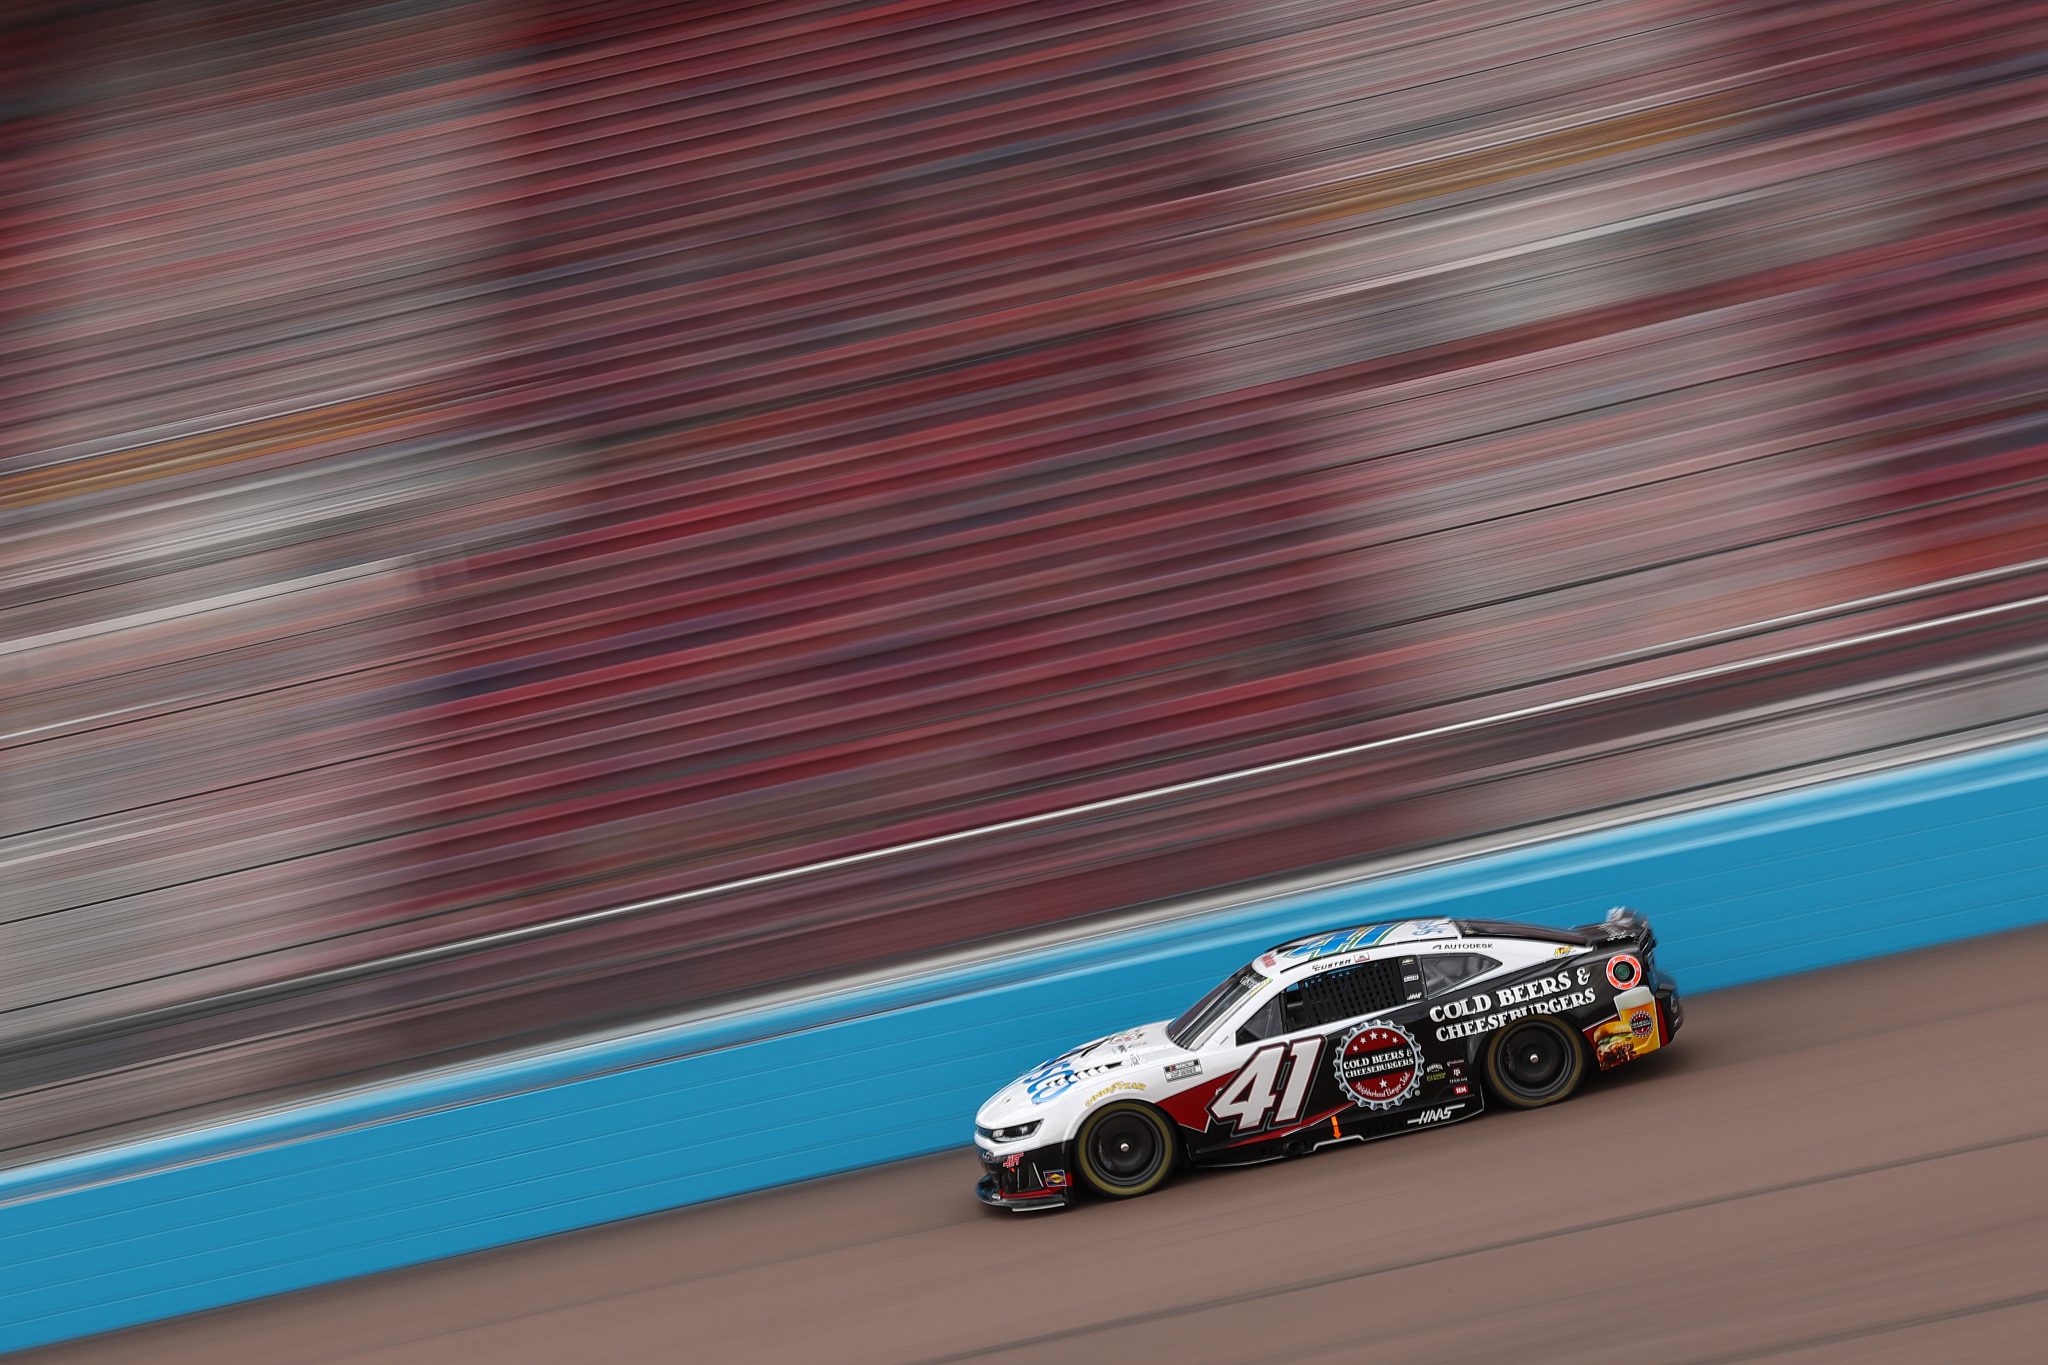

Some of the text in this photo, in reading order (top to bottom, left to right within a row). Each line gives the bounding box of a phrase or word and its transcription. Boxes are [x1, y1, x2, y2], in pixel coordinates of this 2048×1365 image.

[1429, 993, 1492, 1023] COLD
[1496, 971, 1572, 1007] BEERS
[1576, 967, 1591, 986] &
[1435, 987, 1596, 1042] CHEESEBURGERS
[1343, 1057, 1370, 1070] COLD
[1371, 1049, 1404, 1064] BEERS
[1345, 1058, 1414, 1079] CHEESEBURGERS
[1210, 1038, 1321, 1130] 41
[1407, 1103, 1466, 1125] HAAS
